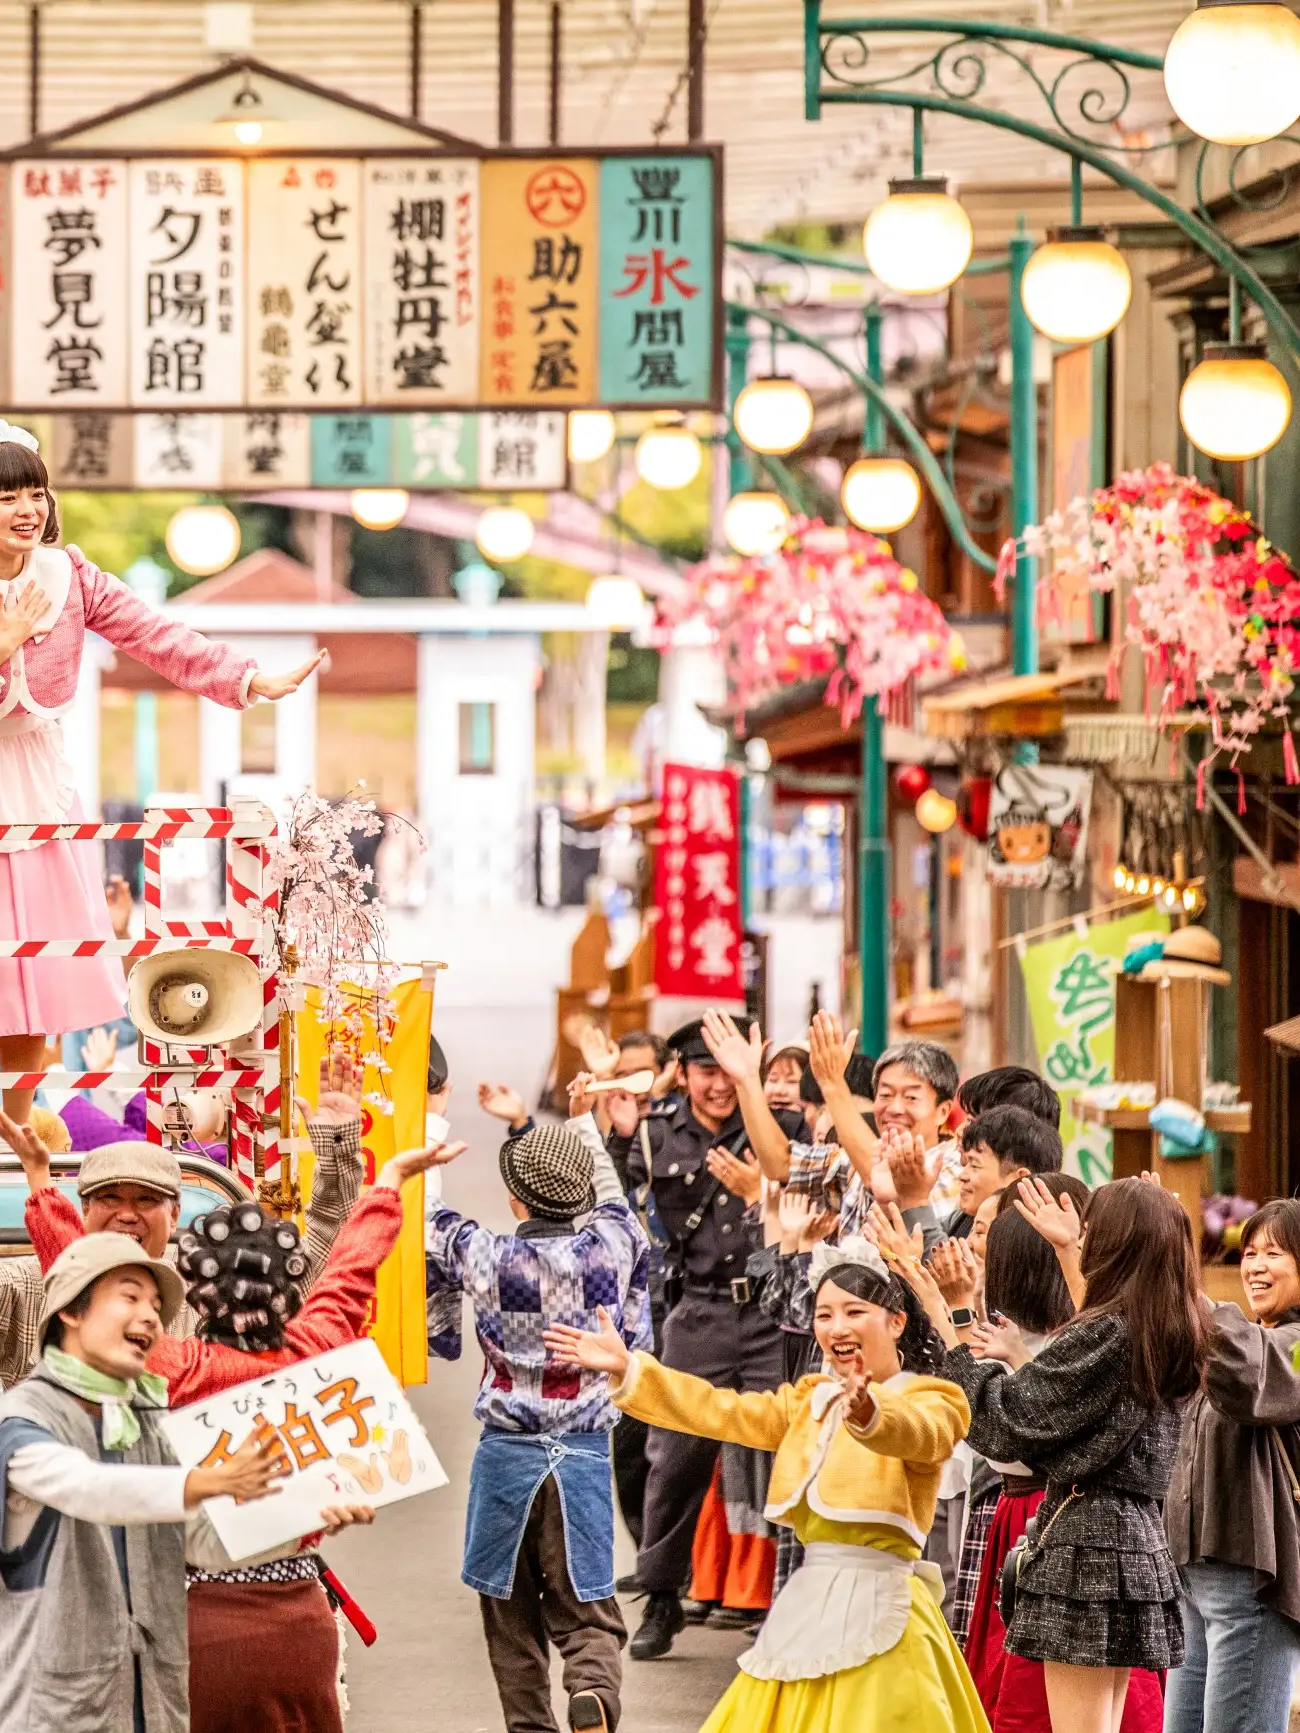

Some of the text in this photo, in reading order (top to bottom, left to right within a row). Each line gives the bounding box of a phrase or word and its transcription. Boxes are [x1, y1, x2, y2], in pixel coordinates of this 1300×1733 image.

[42, 206, 103, 393] 夢見堂
[145, 205, 207, 392] 夕陽館
[387, 197, 451, 389] 棚牡丹堂
[528, 234, 583, 392] 助六屋
